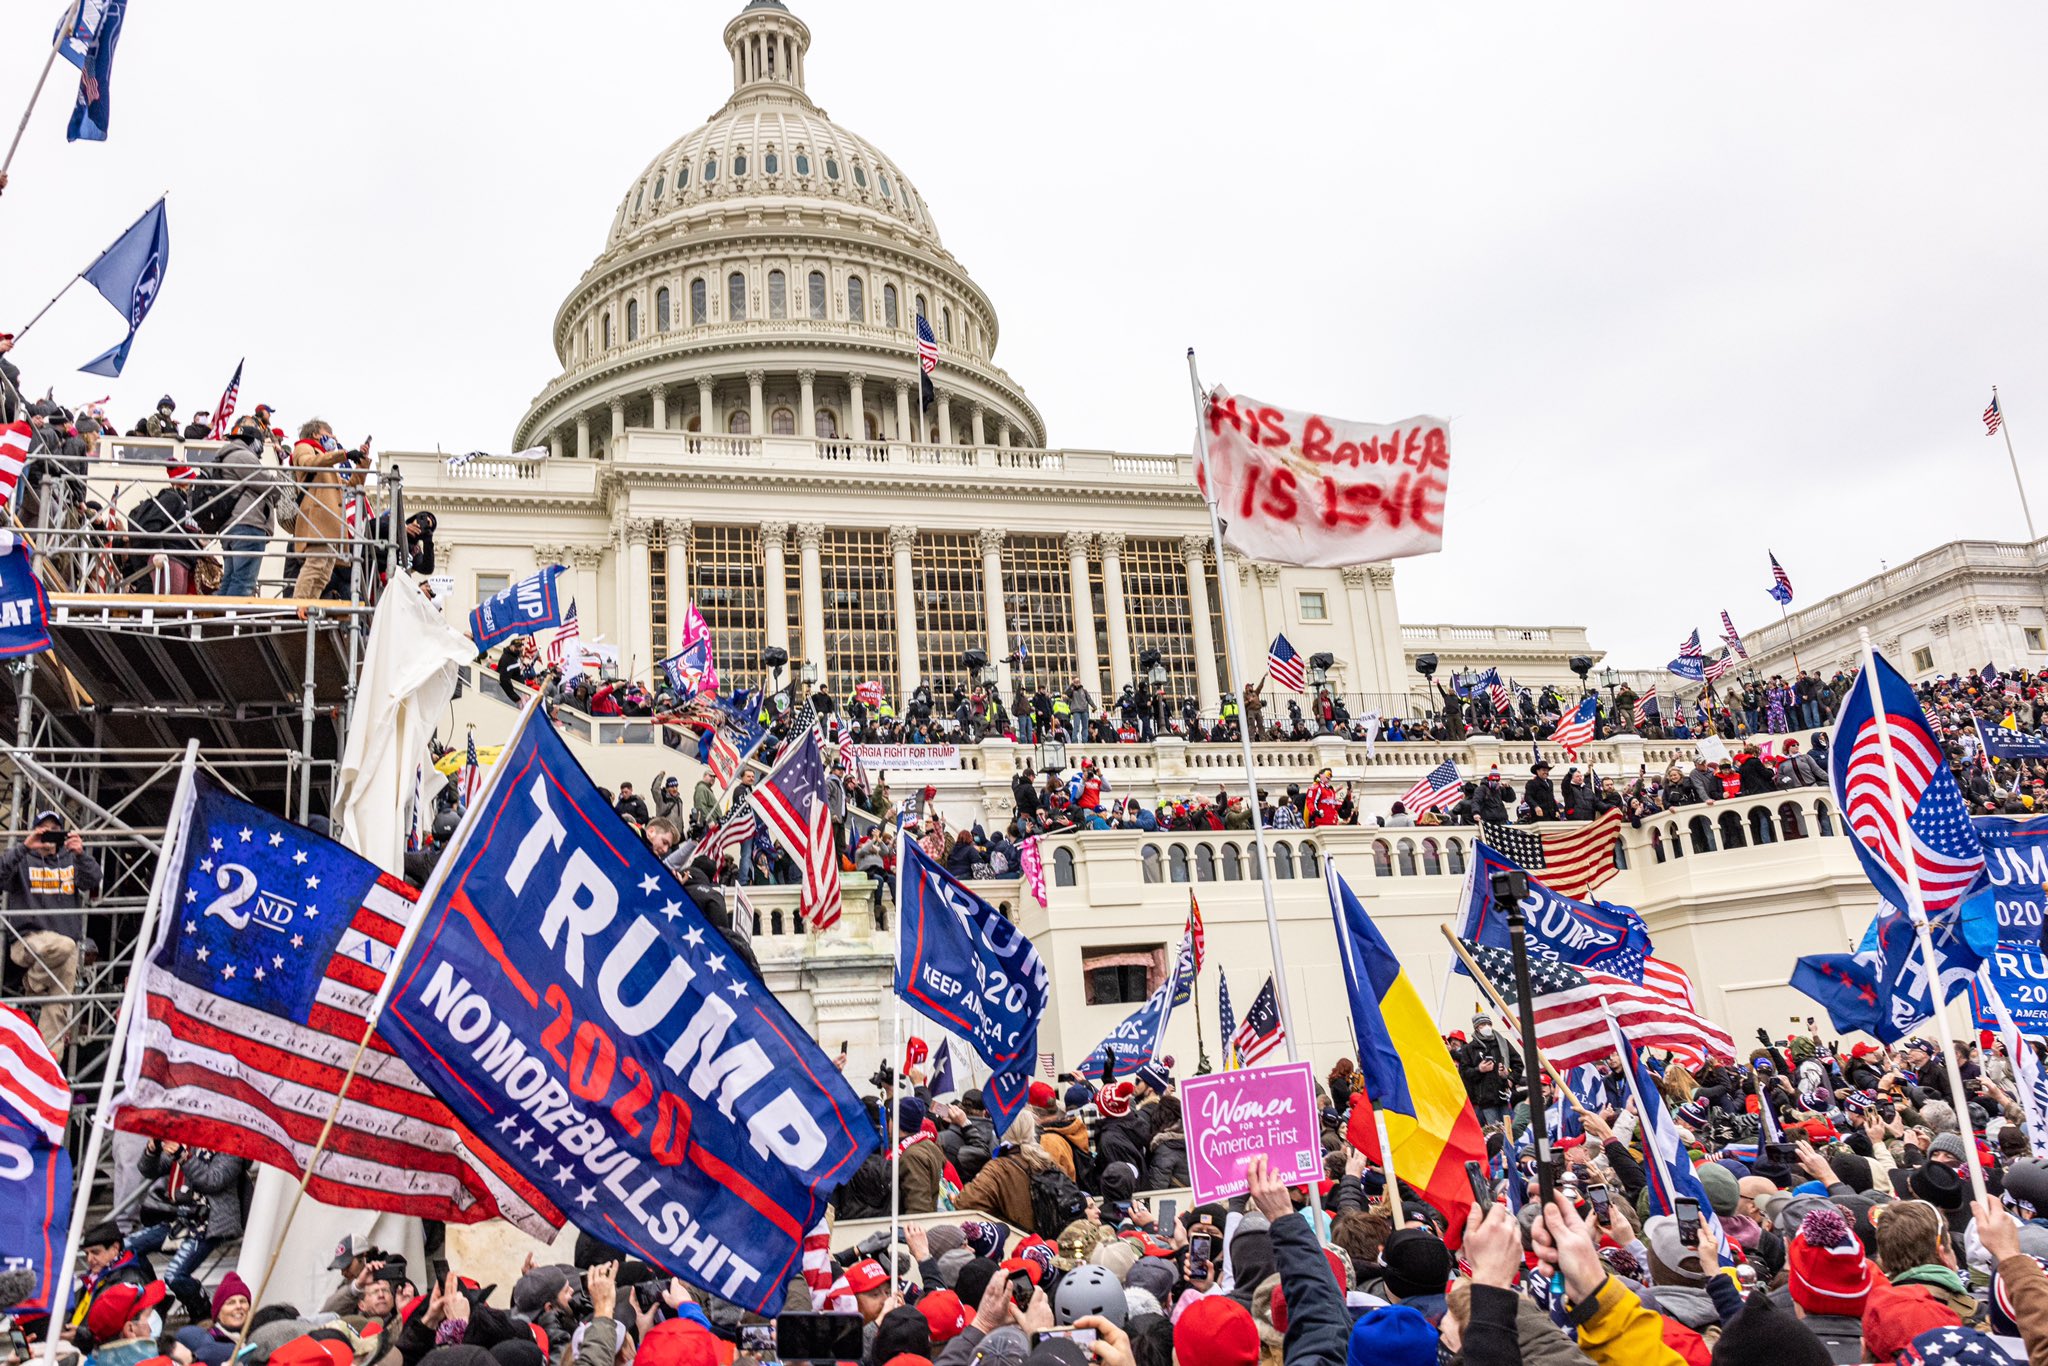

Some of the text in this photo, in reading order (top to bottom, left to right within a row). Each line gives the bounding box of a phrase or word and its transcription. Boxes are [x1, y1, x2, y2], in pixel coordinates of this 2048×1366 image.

[1303, 416, 1450, 474] BANNER
[1240, 464, 1297, 520] IS
[884, 747, 907, 758] FIGHT
[909, 748, 925, 758] FOR
[927, 747, 955, 757] TRUMP
[910, 759, 944, 767] Republicans
[1519, 890, 1617, 950] RUMP
[1995, 900, 2042, 926] 020
[1524, 933, 1560, 962] 020
[505, 773, 828, 1172] TRUMP
[923, 962, 962, 998] KEEP
[541, 983, 692, 1166] 2020
[1202, 1088, 1296, 1128] Women
[1210, 1127, 1298, 1158] America First
[1239, 1122, 1254, 1131] FOR
